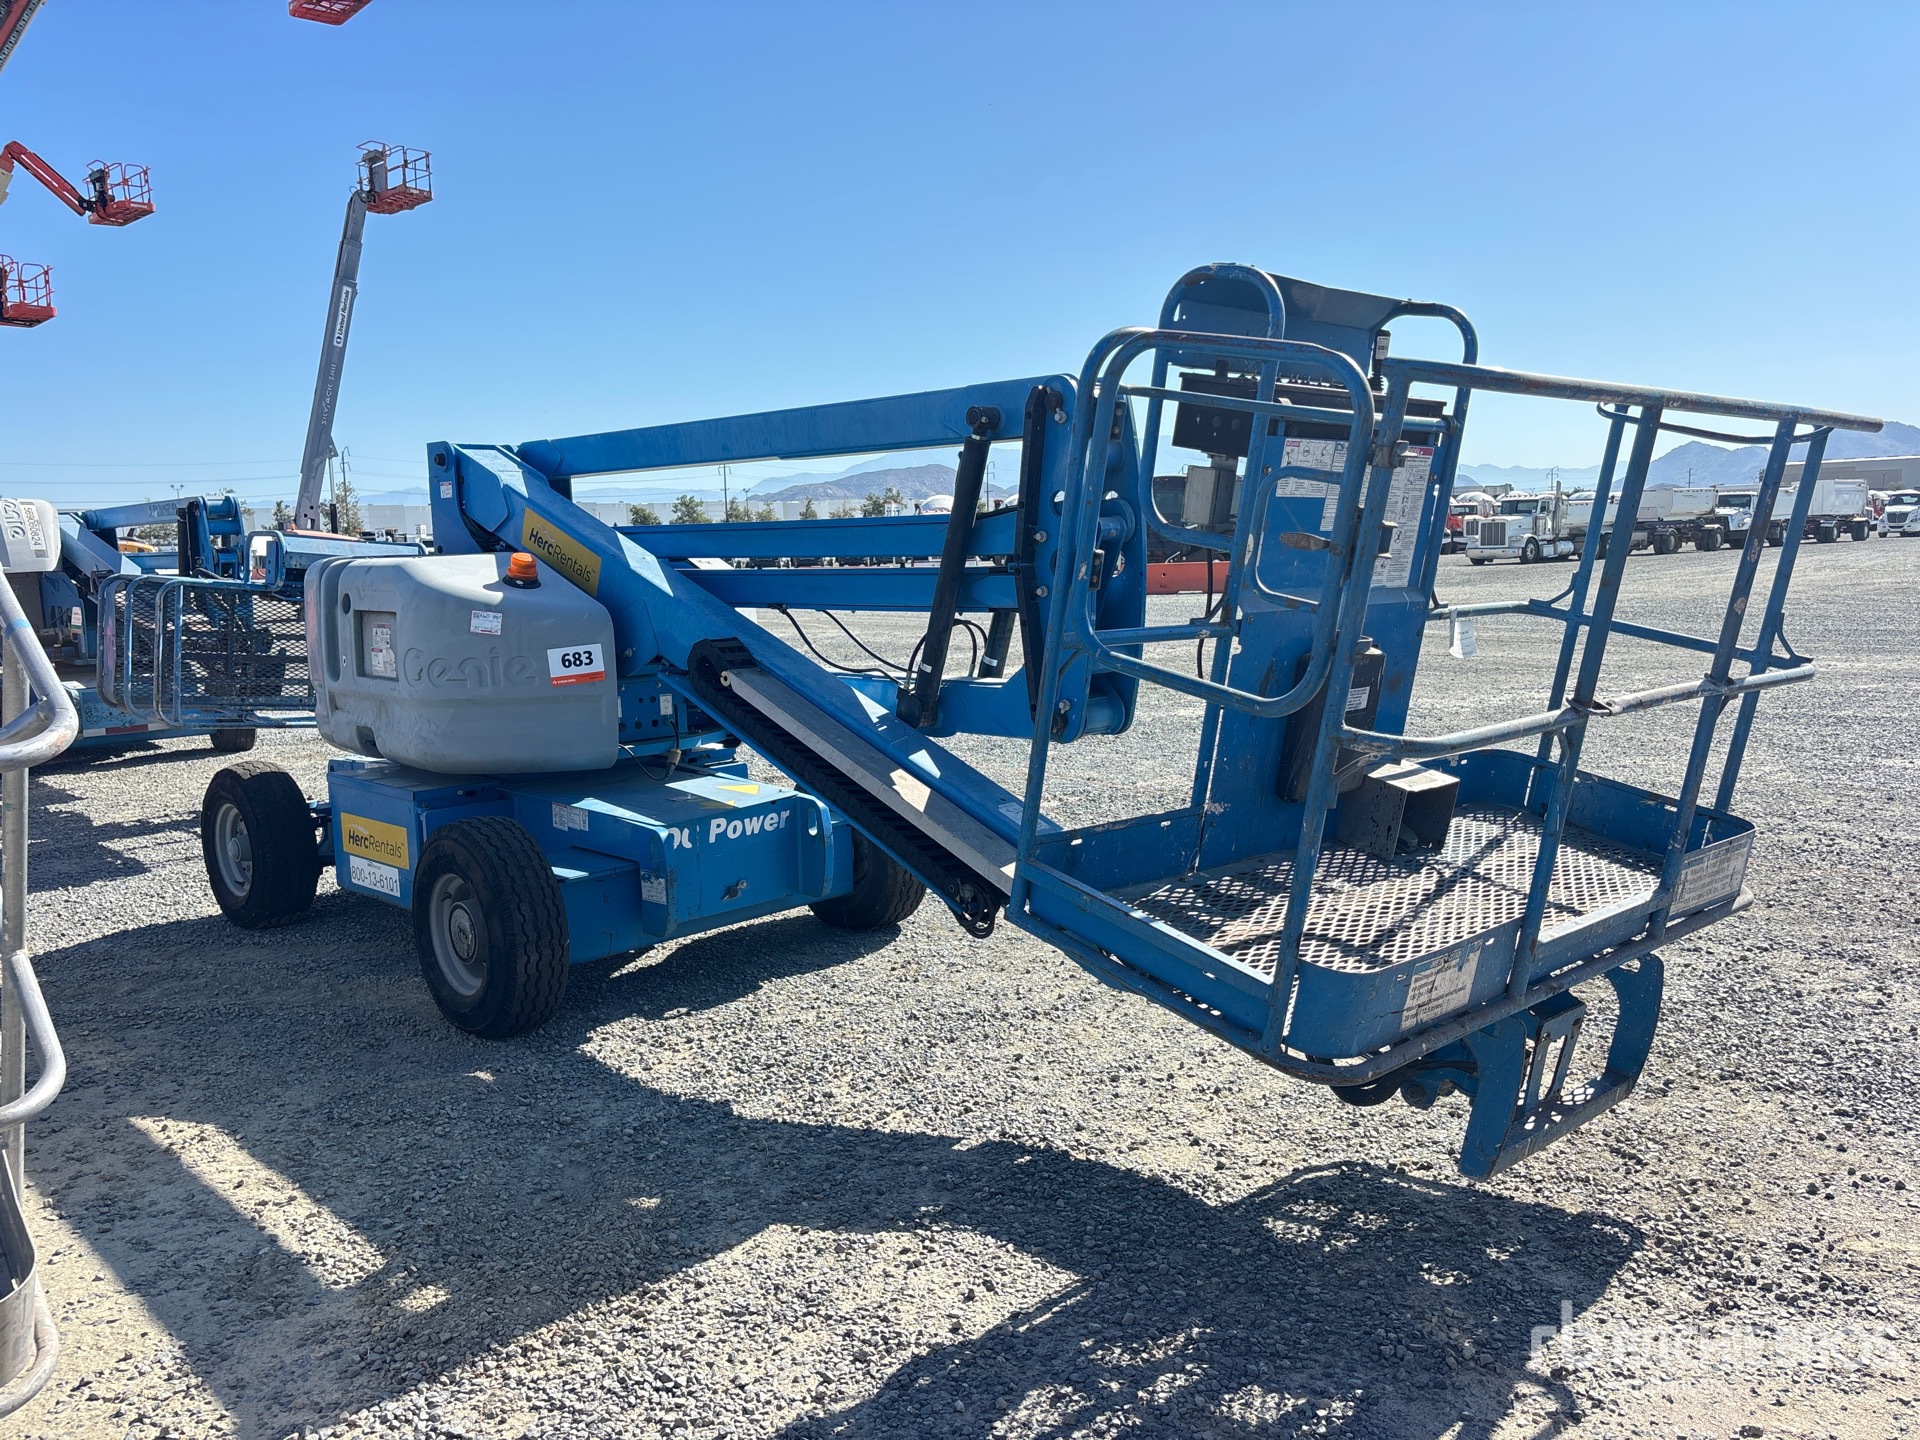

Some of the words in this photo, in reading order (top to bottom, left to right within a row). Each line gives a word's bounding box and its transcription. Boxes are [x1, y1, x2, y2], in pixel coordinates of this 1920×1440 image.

[337, 313, 346, 335] United
[342, 290, 350, 313] Rentals
[403, 646, 537, 688] Genie
[561, 650, 594, 668] 683
[708, 809, 790, 843] Power
[351, 865, 399, 893] 800-13-6101
